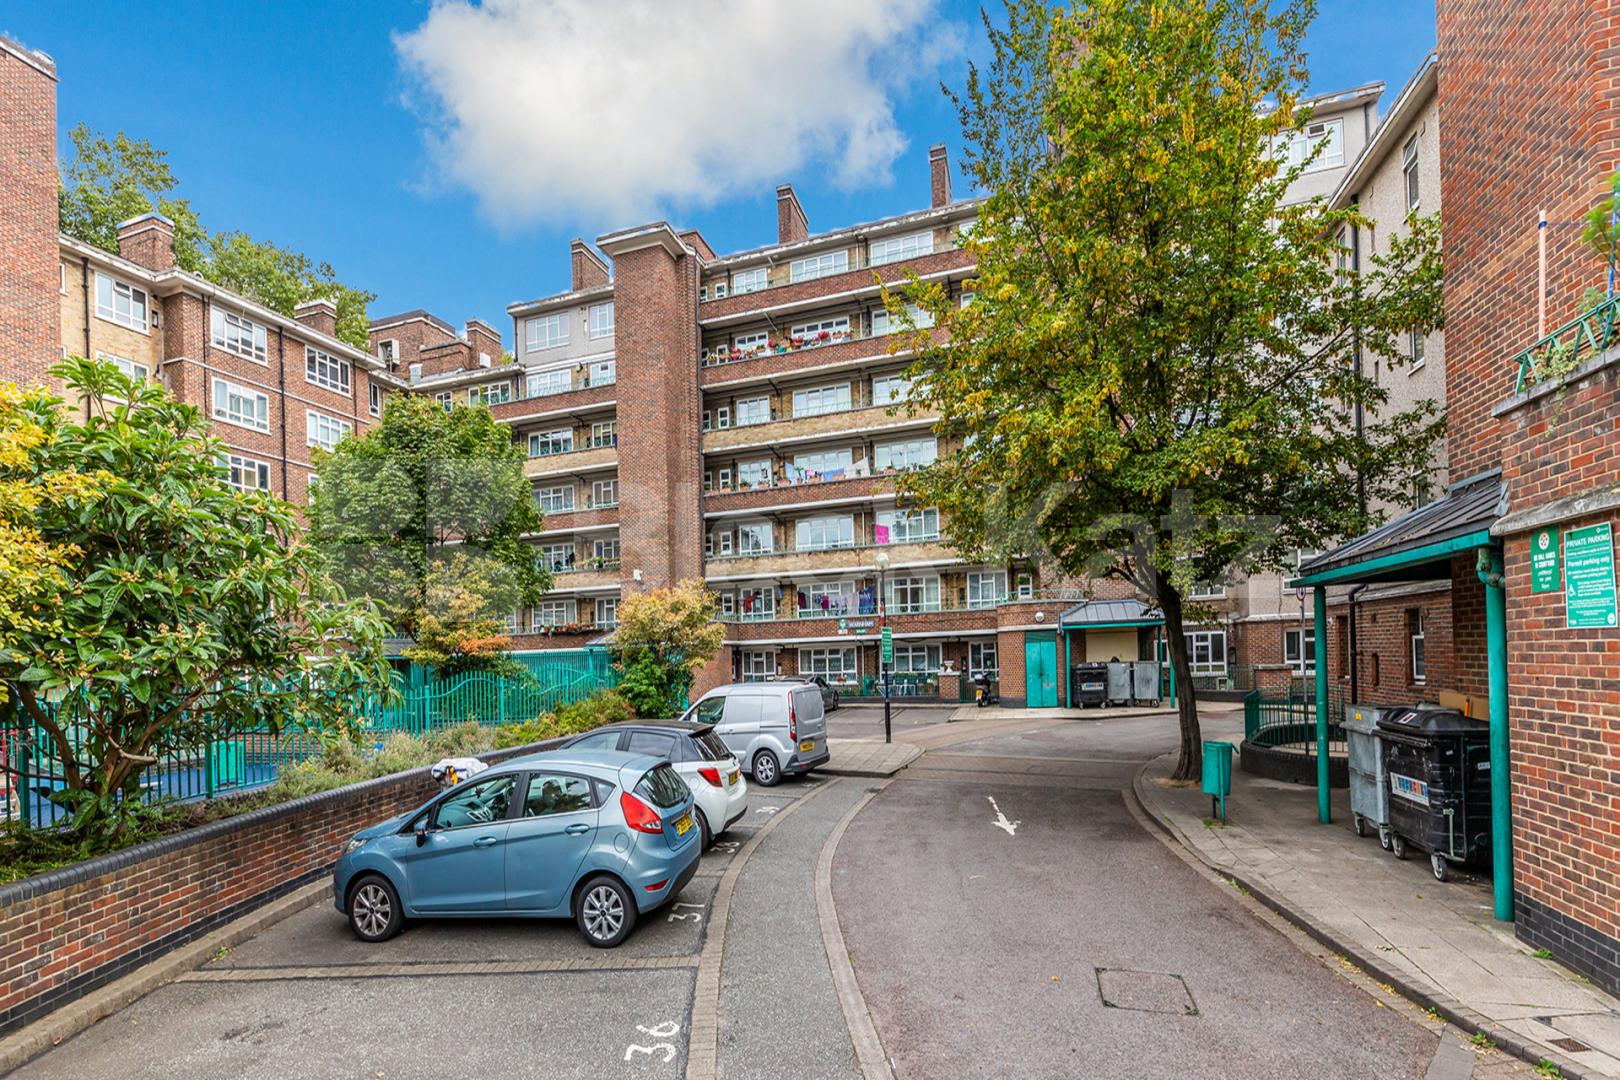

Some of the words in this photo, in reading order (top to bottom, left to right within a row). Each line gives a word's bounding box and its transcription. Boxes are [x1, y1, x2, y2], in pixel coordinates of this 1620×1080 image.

[1567, 538, 1587, 547] PRIVATE
[1588, 533, 1610, 544] PARKING
[1567, 560, 1582, 568] Permit
[1583, 558, 1600, 566] parking
[623, 1020, 680, 1062] 36
